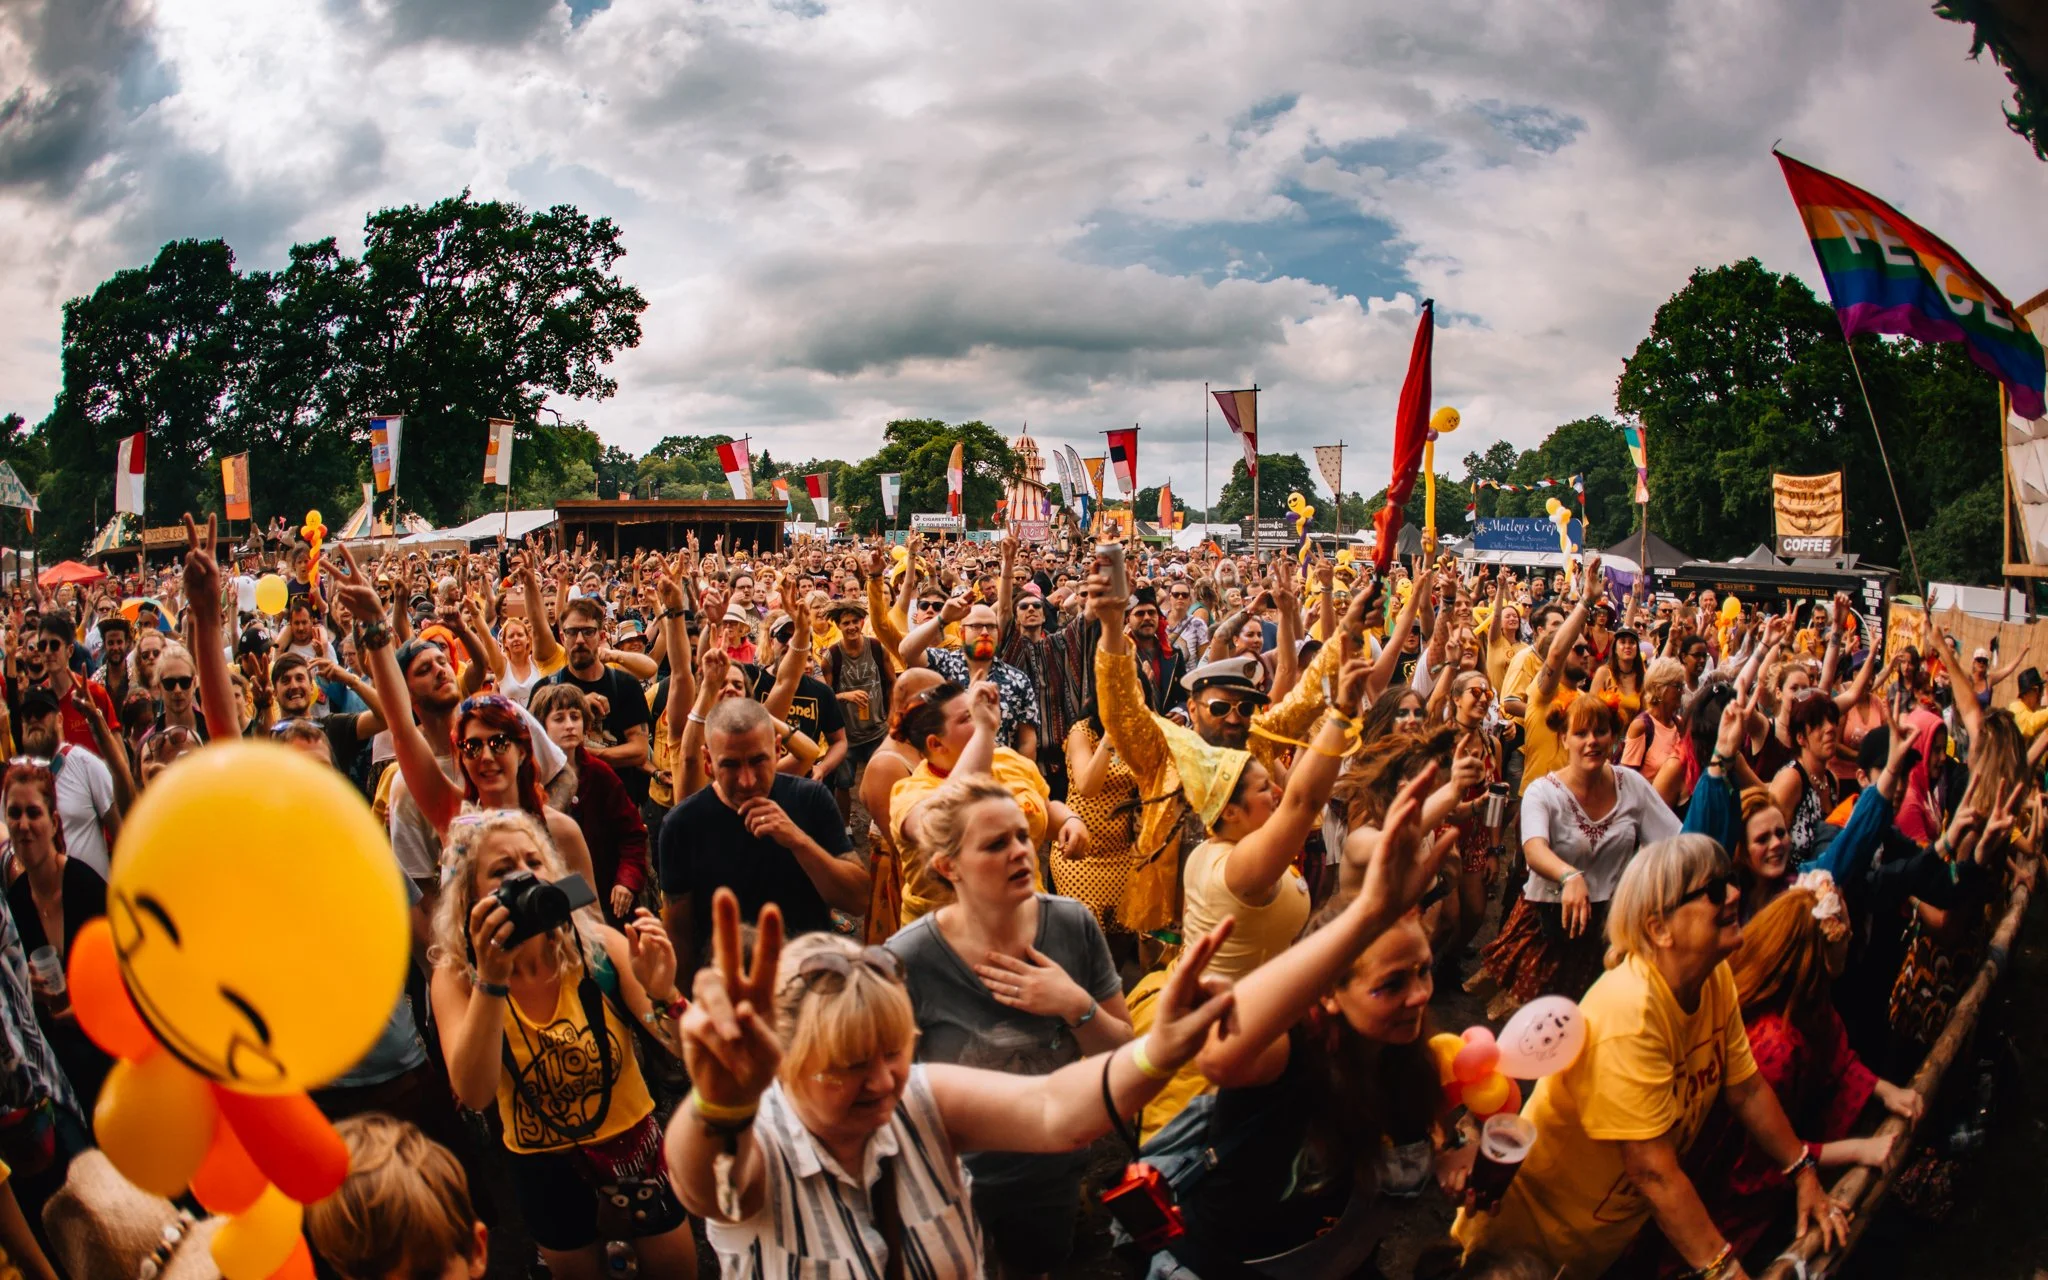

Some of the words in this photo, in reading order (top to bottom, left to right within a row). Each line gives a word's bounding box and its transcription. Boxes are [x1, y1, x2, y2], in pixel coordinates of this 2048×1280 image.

[1830, 207, 2015, 333] PECE
[1788, 491, 1827, 506] PIZZA
[1488, 519, 1530, 535] Mutley's
[1783, 538, 1832, 553] COFFEE
[1777, 586, 1810, 596] WOODFIRED
[1811, 588, 1829, 597] PIZZA
